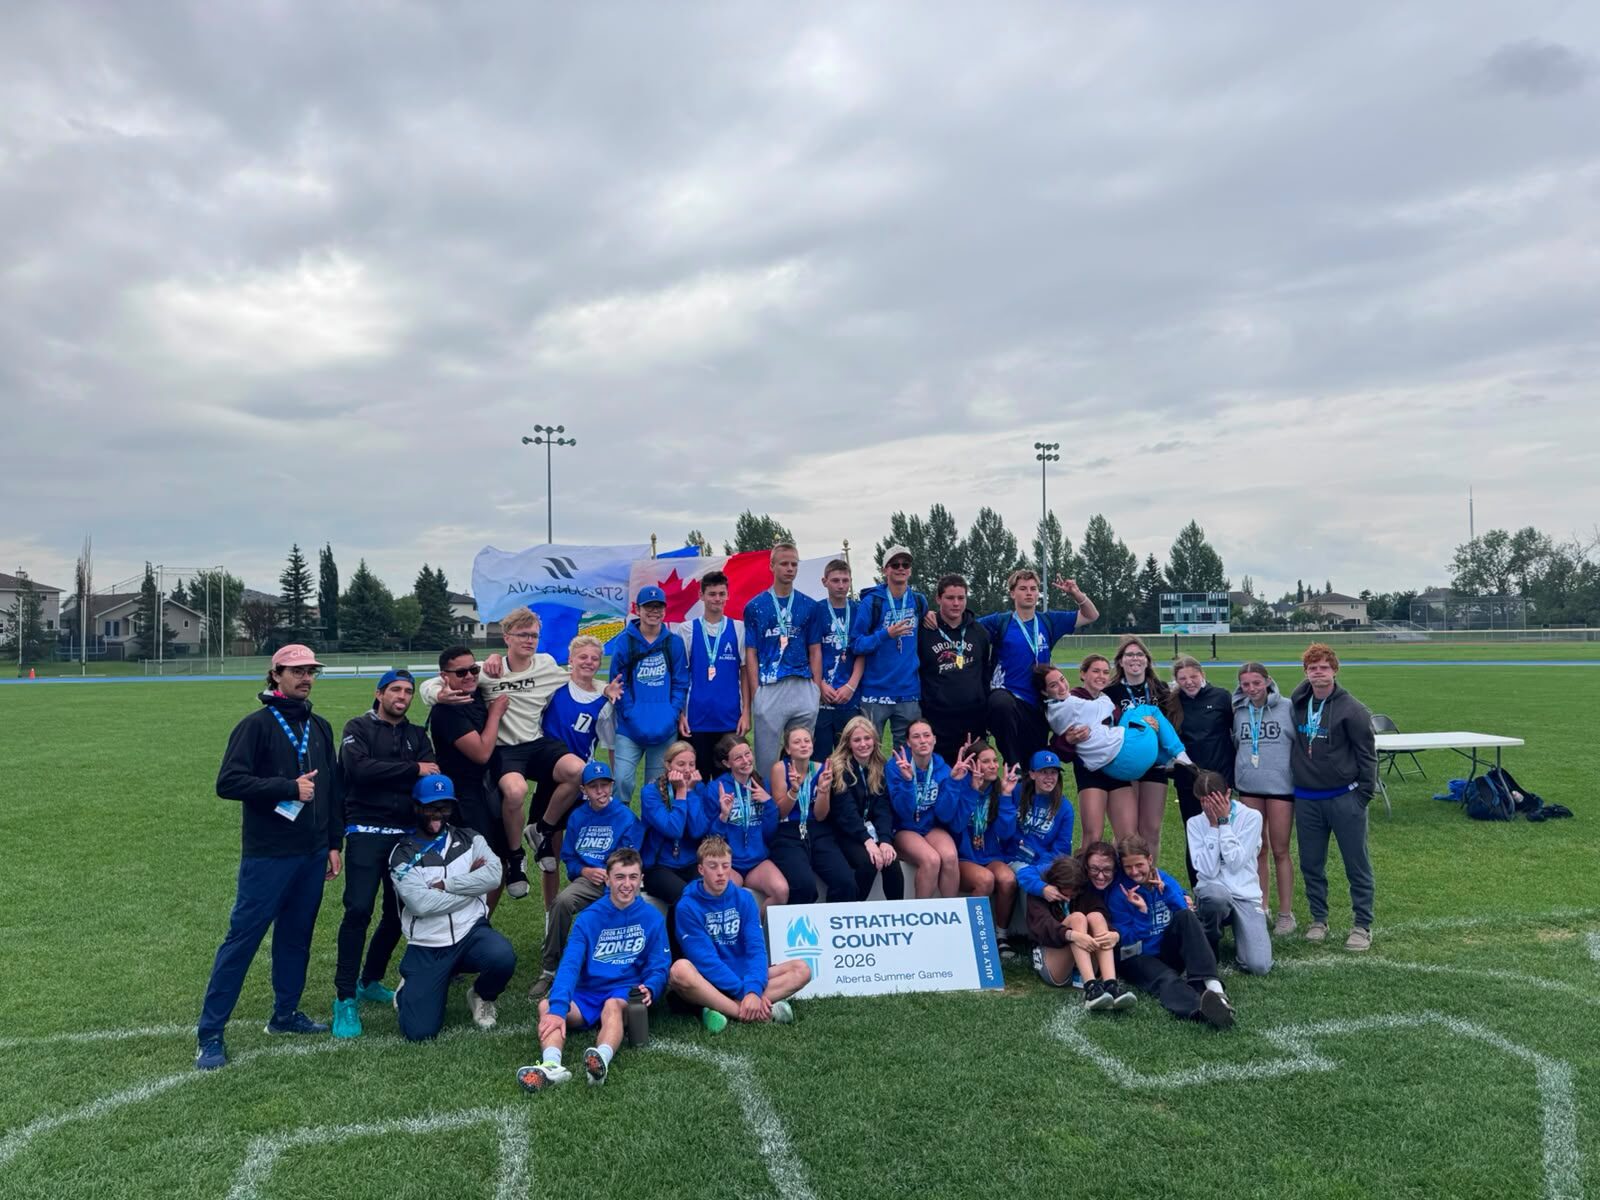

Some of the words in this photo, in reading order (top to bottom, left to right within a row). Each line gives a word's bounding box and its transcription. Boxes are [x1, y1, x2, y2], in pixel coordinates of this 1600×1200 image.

[938, 656, 974, 675] FOOTLL
[578, 715, 590, 730] 7
[830, 911, 962, 930] STRATHCONA
[975, 905, 985, 926] 2026
[832, 931, 914, 949] COUNTY
[980, 928, 990, 954] 16-19,
[833, 953, 876, 969] 2026
[984, 958, 994, 981] JULY
[835, 975, 872, 984] Alberta
[874, 972, 915, 982] Summer
[918, 970, 953, 980] Games
